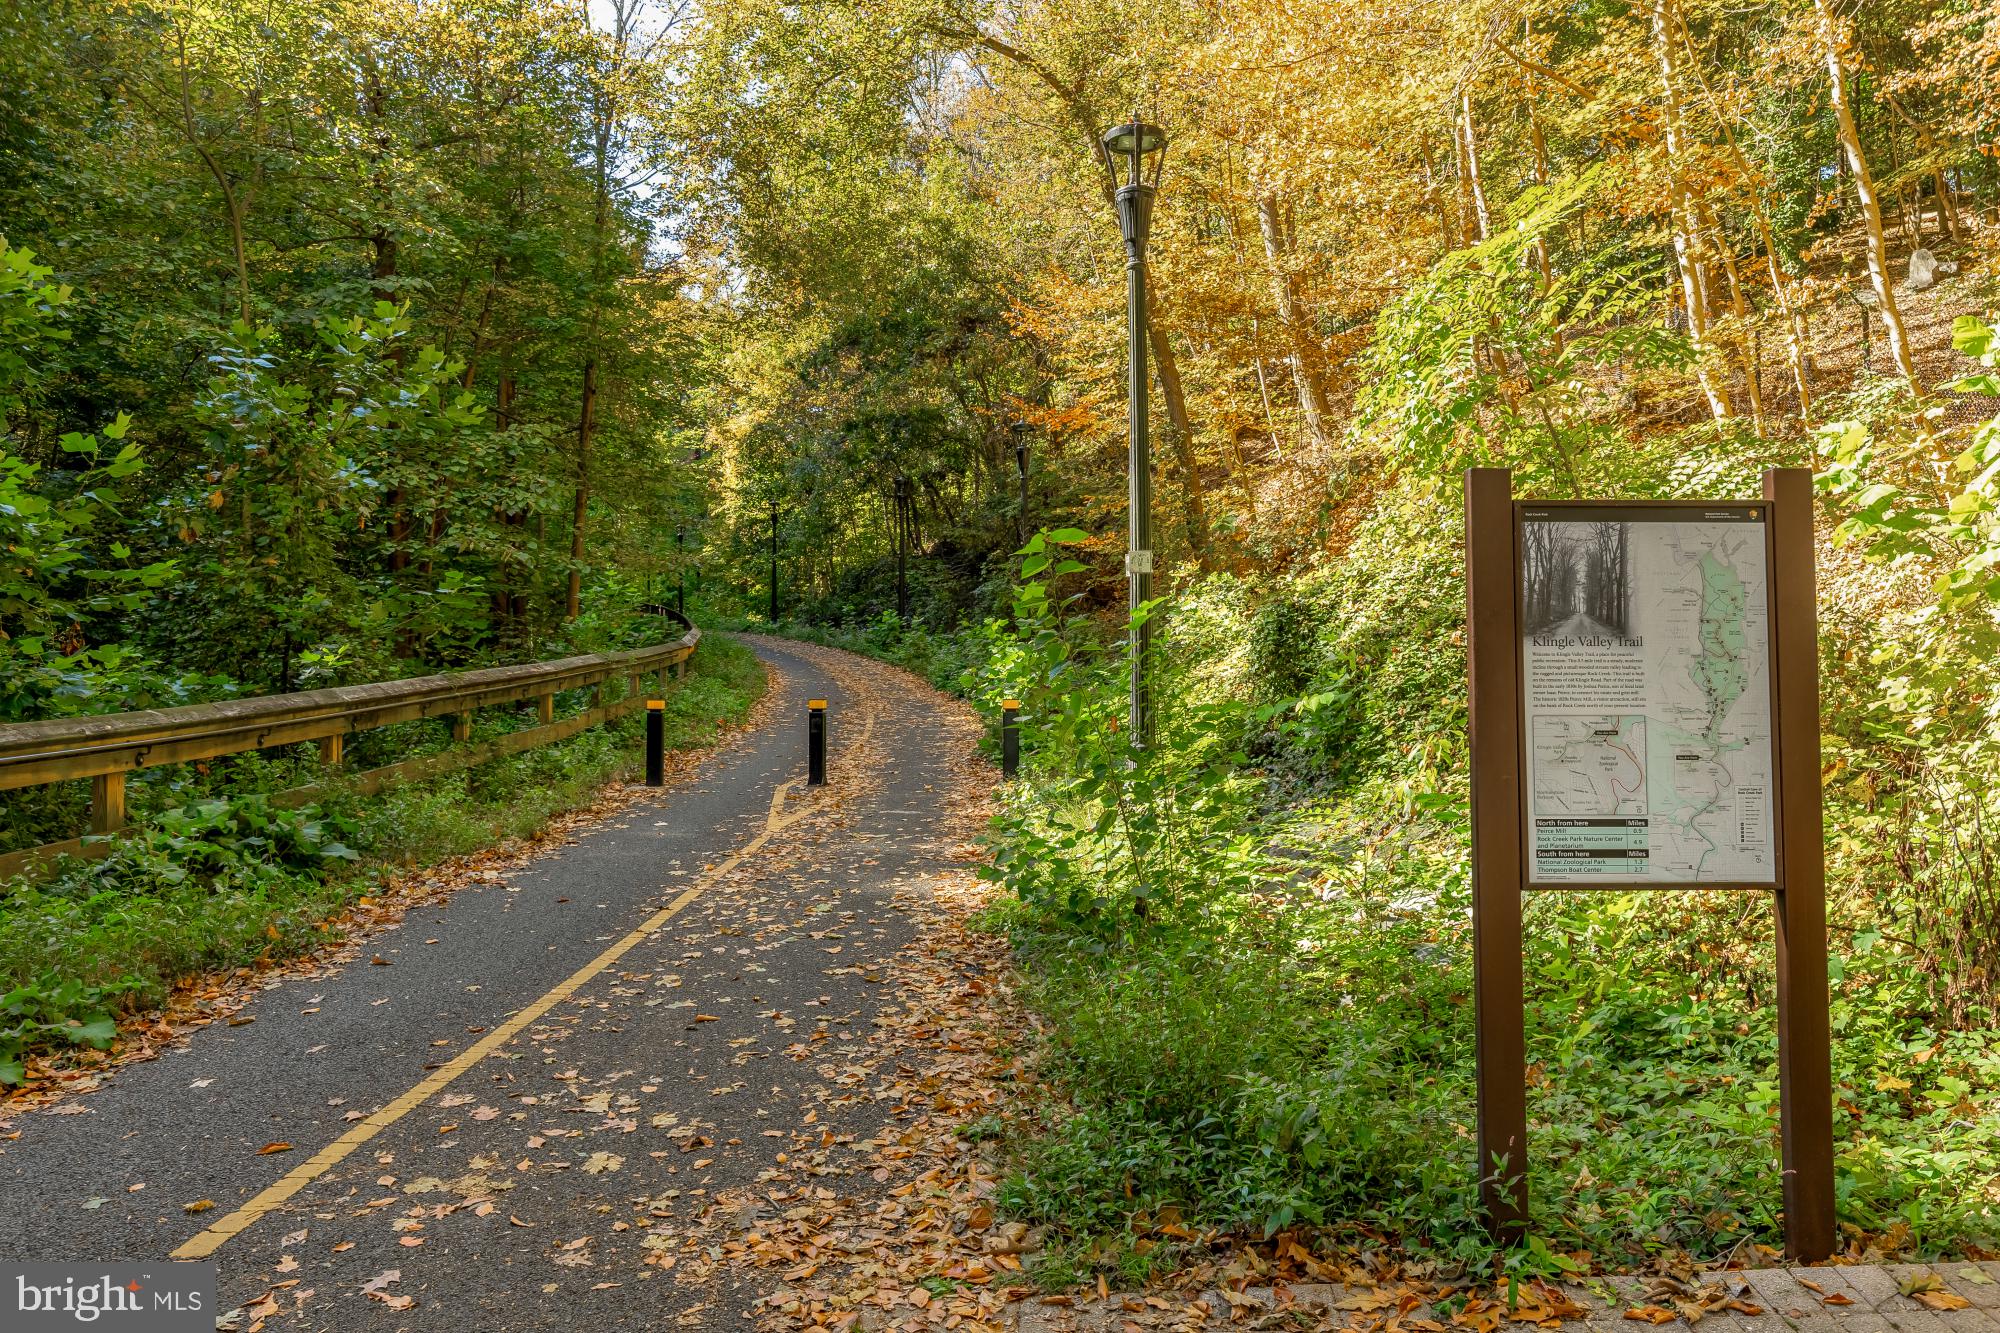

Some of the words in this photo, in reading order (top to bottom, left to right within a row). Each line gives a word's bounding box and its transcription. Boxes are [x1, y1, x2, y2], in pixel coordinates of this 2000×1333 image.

[1533, 636, 1574, 649] Klingle
[1578, 636, 1613, 649] Valley
[1616, 636, 1643, 646] Trail
